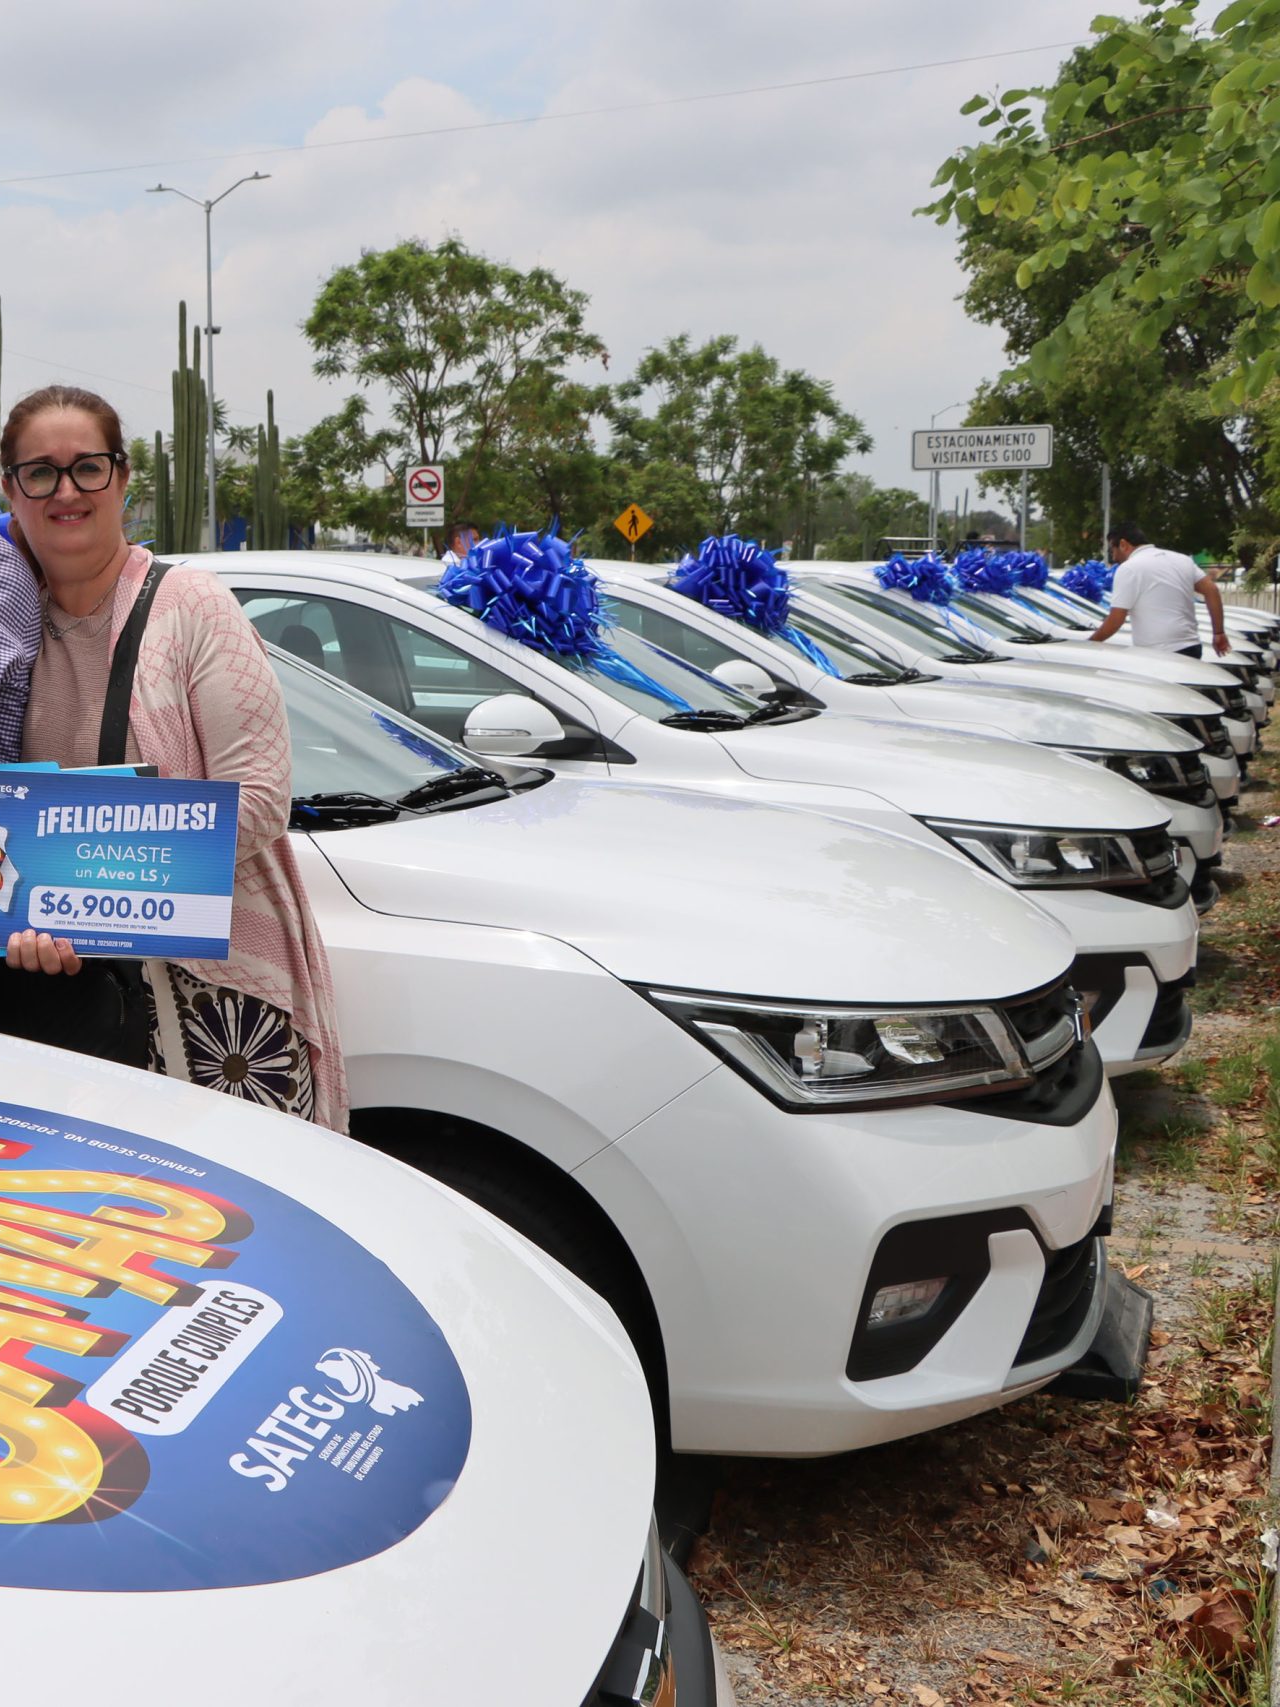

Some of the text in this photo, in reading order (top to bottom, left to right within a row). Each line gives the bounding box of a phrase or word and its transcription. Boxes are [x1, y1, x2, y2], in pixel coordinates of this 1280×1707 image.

[927, 432, 1036, 449] ESTACIONAMIENTO
[932, 449, 1031, 464] VISITANTES G100
[36, 802, 216, 837] ¡FELICIDADES!
[76, 843, 172, 864] GANASTE
[75, 867, 170, 886] un Aveo LS y
[40, 890, 174, 920] $6,900.00
[64, 1131, 86, 1144] NO.
[88, 1138, 137, 1158] SEGOB
[138, 1154, 207, 1178] PERMISO
[110, 1290, 264, 1424] PORQUE CUMPLES
[229, 1385, 345, 1492] SATEG
[318, 1434, 344, 1460] SERVICIO DE
[330, 1431, 362, 1468] ADMINISTRACIÓN
[360, 1439, 372, 1450] DEL
[366, 1424, 384, 1442] ESTADO
[354, 1446, 384, 1480] DE GUANAJUATO
